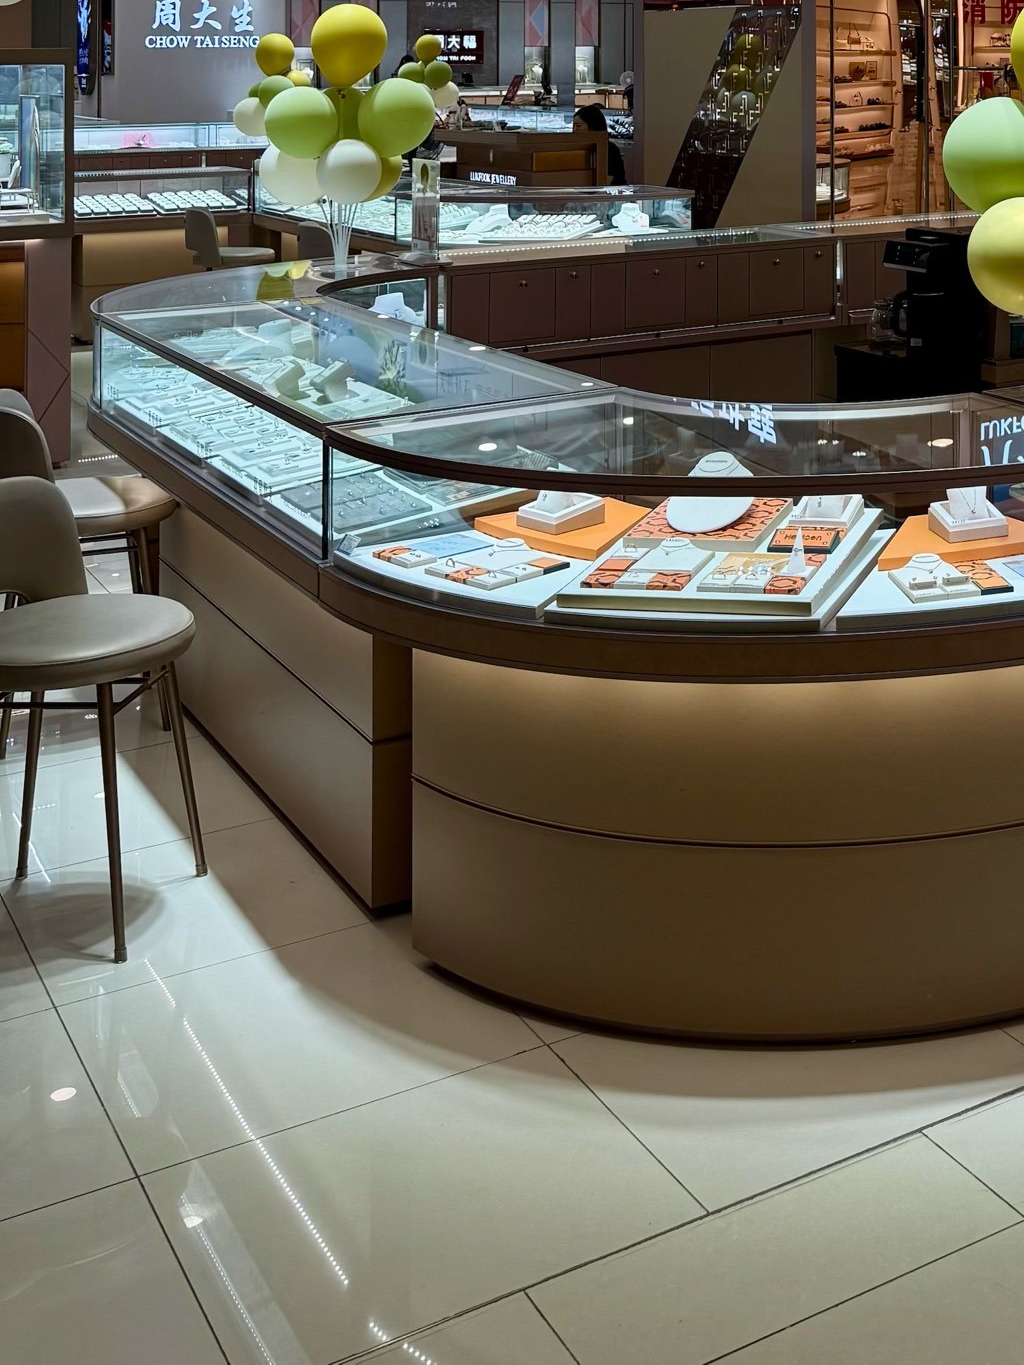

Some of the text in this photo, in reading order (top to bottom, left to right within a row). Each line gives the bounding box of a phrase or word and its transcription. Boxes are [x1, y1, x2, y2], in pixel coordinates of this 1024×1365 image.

[145, 35, 260, 48] CHOW TAI SENG
[491, 174, 517, 186] JEWELLERY
